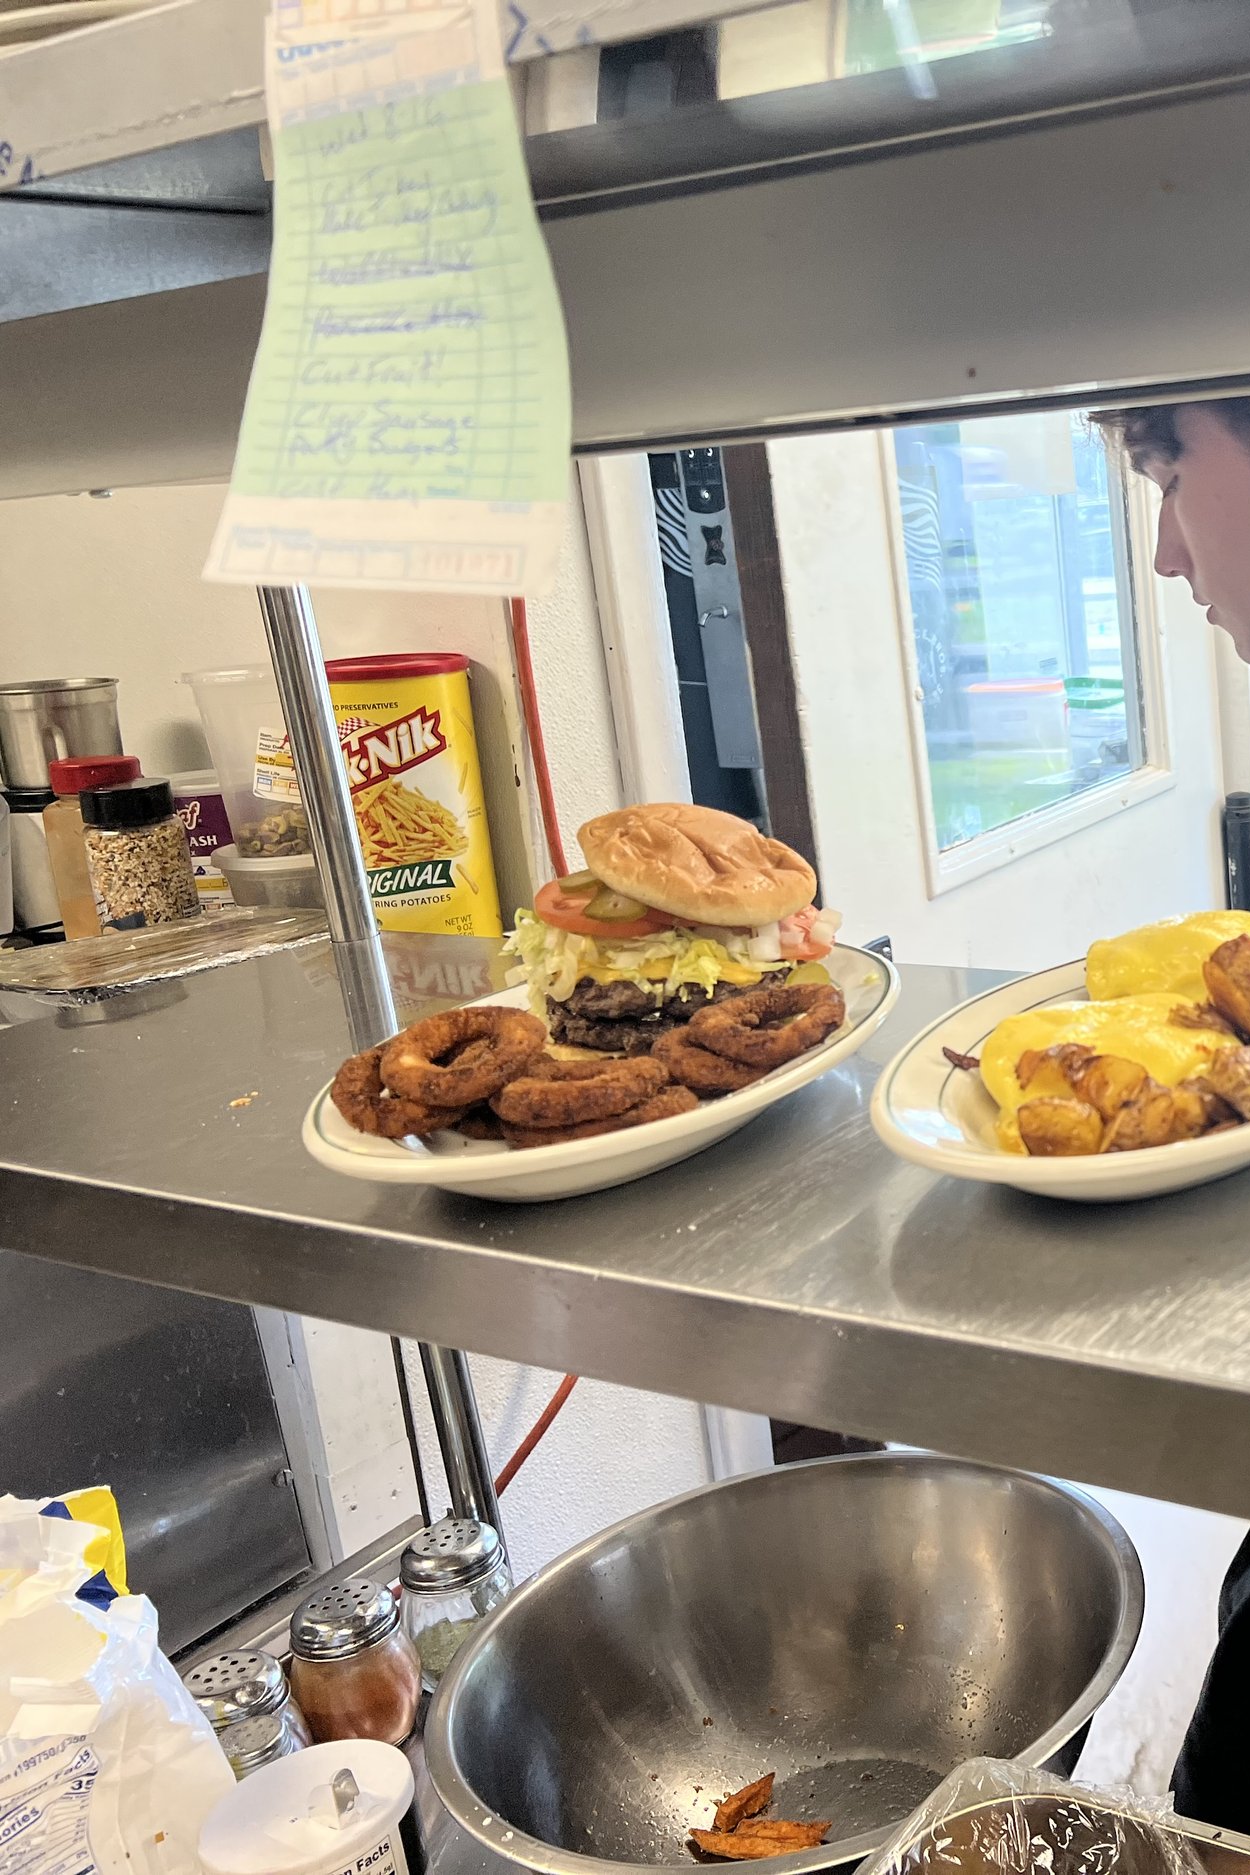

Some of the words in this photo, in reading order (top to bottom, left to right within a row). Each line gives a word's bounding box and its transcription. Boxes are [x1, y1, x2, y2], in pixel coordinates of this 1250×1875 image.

[341, 702, 399, 711] PRESERVATIVES
[189, 834, 218, 847] ASH
[367, 863, 447, 896] IGINAL
[374, 899, 398, 909] RING
[401, 894, 452, 907] POTATOES
[444, 916, 459, 927] NET
[460, 914, 472, 924] WT
[456, 925, 462, 933] 9
[462, 922, 474, 931] OZ
[0, 1807, 40, 1842] ories
[356, 1842, 390, 1872] Facts
